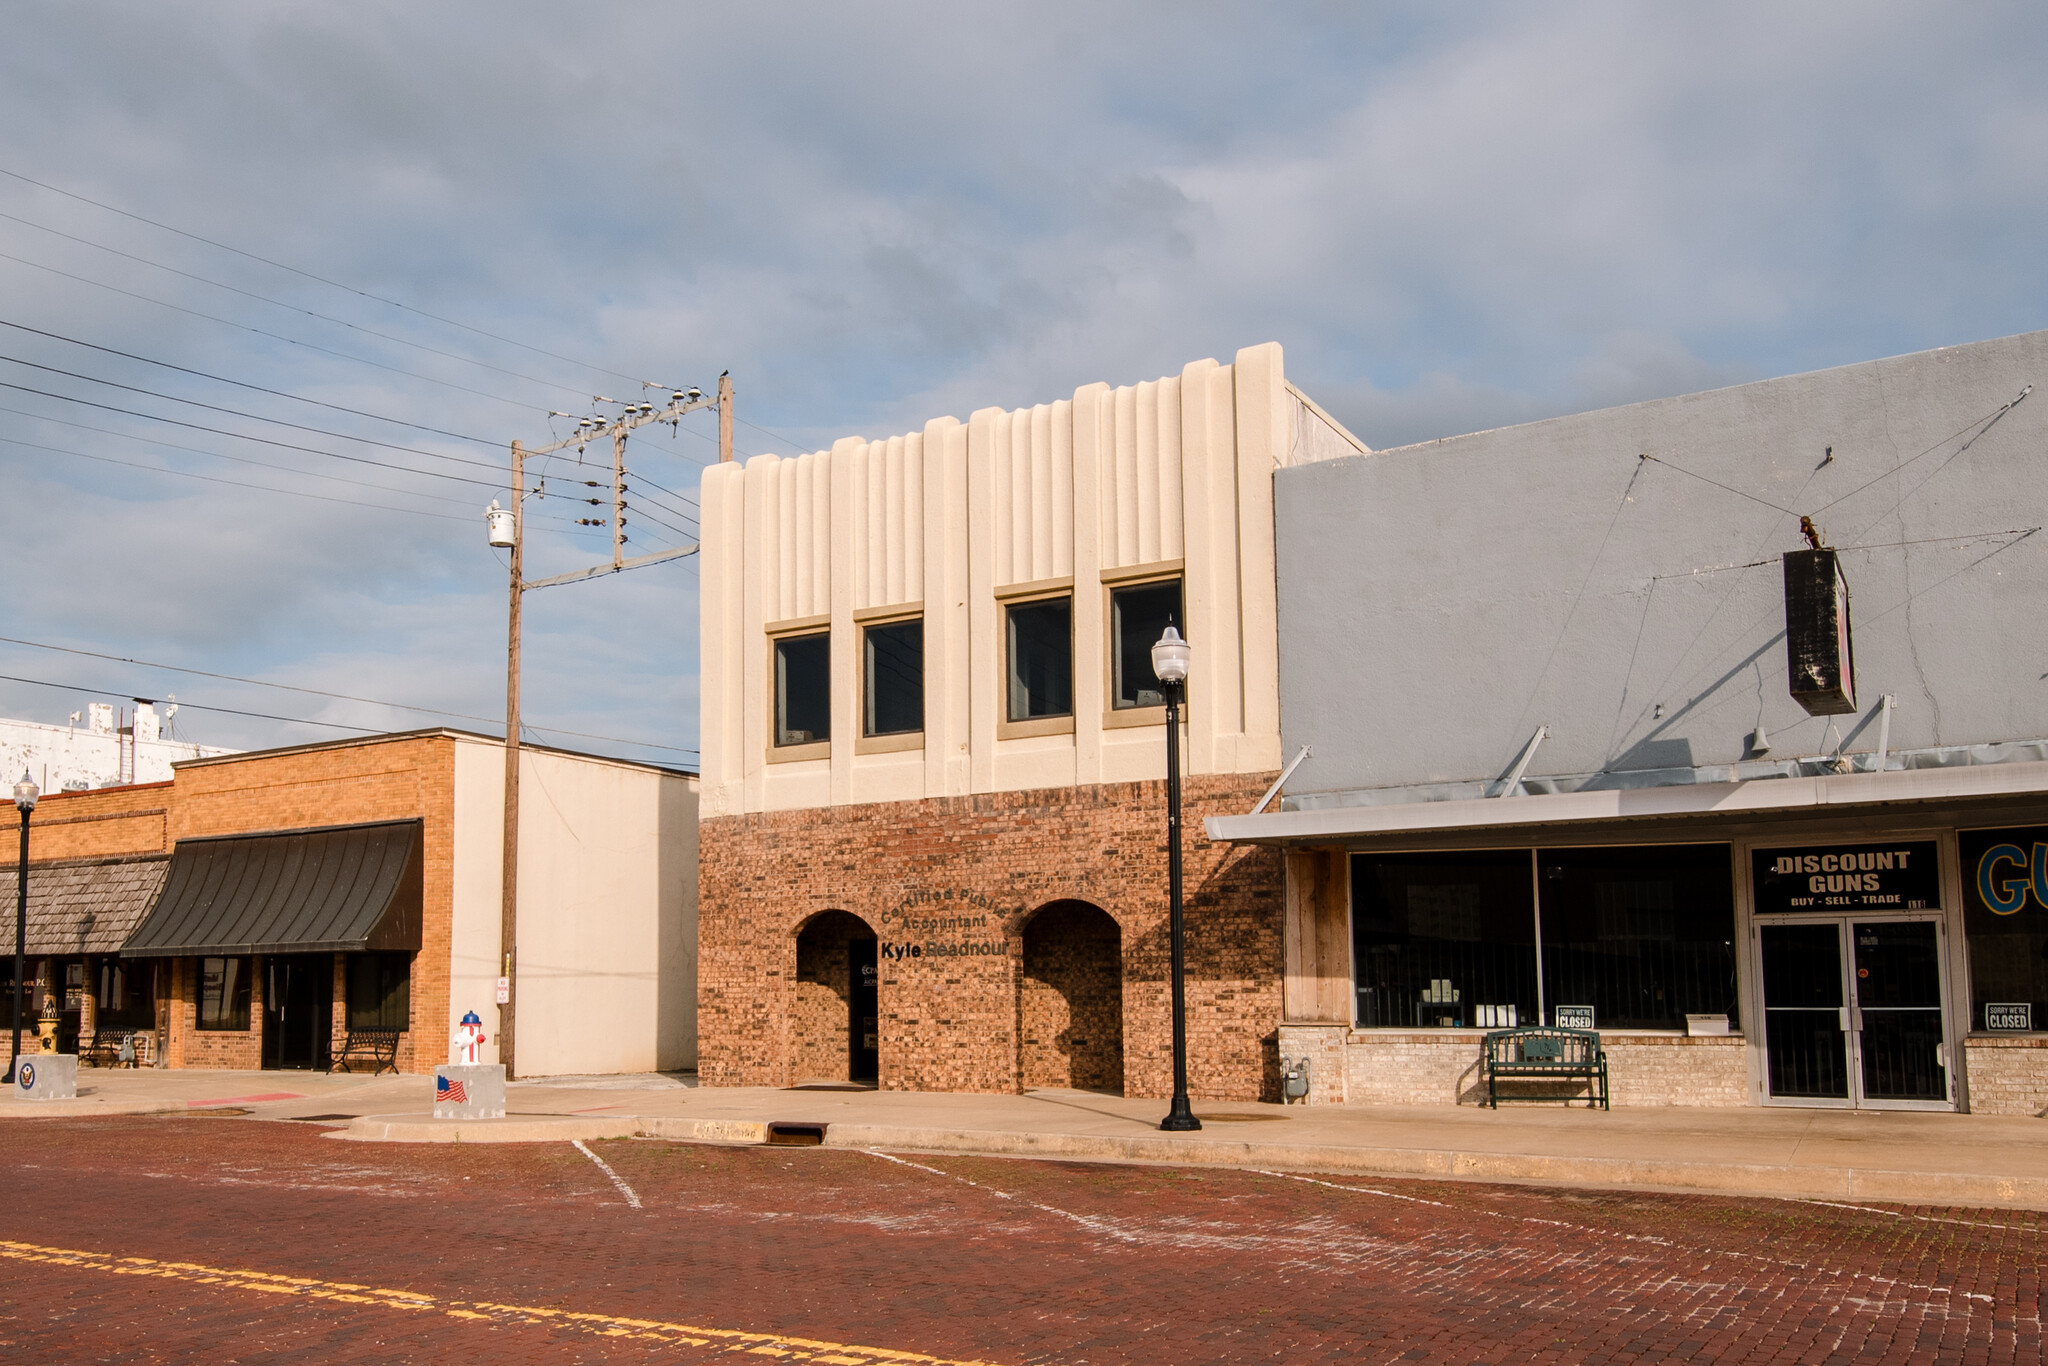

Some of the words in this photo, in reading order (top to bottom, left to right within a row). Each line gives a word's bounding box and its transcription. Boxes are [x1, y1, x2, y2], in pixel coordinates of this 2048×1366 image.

[1777, 851, 1910, 875] DISCOUNT
[1809, 873, 1880, 893] GUNS
[881, 888, 953, 924] Certified
[960, 889, 1007, 919] Public
[1791, 897, 1814, 906] BUY
[1825, 896, 1851, 905] SELL
[1862, 894, 1901, 904] TRADE
[901, 914, 987, 929] Accountant
[881, 942, 921, 962] Kyle
[926, 941, 1009, 957] Readnour
[1560, 1008, 1575, 1016] SORRY
[1990, 1006, 2008, 1014] SORRY
[1559, 1015, 1591, 1028] CLOSED
[1990, 1014, 2027, 1028] CLOSED
